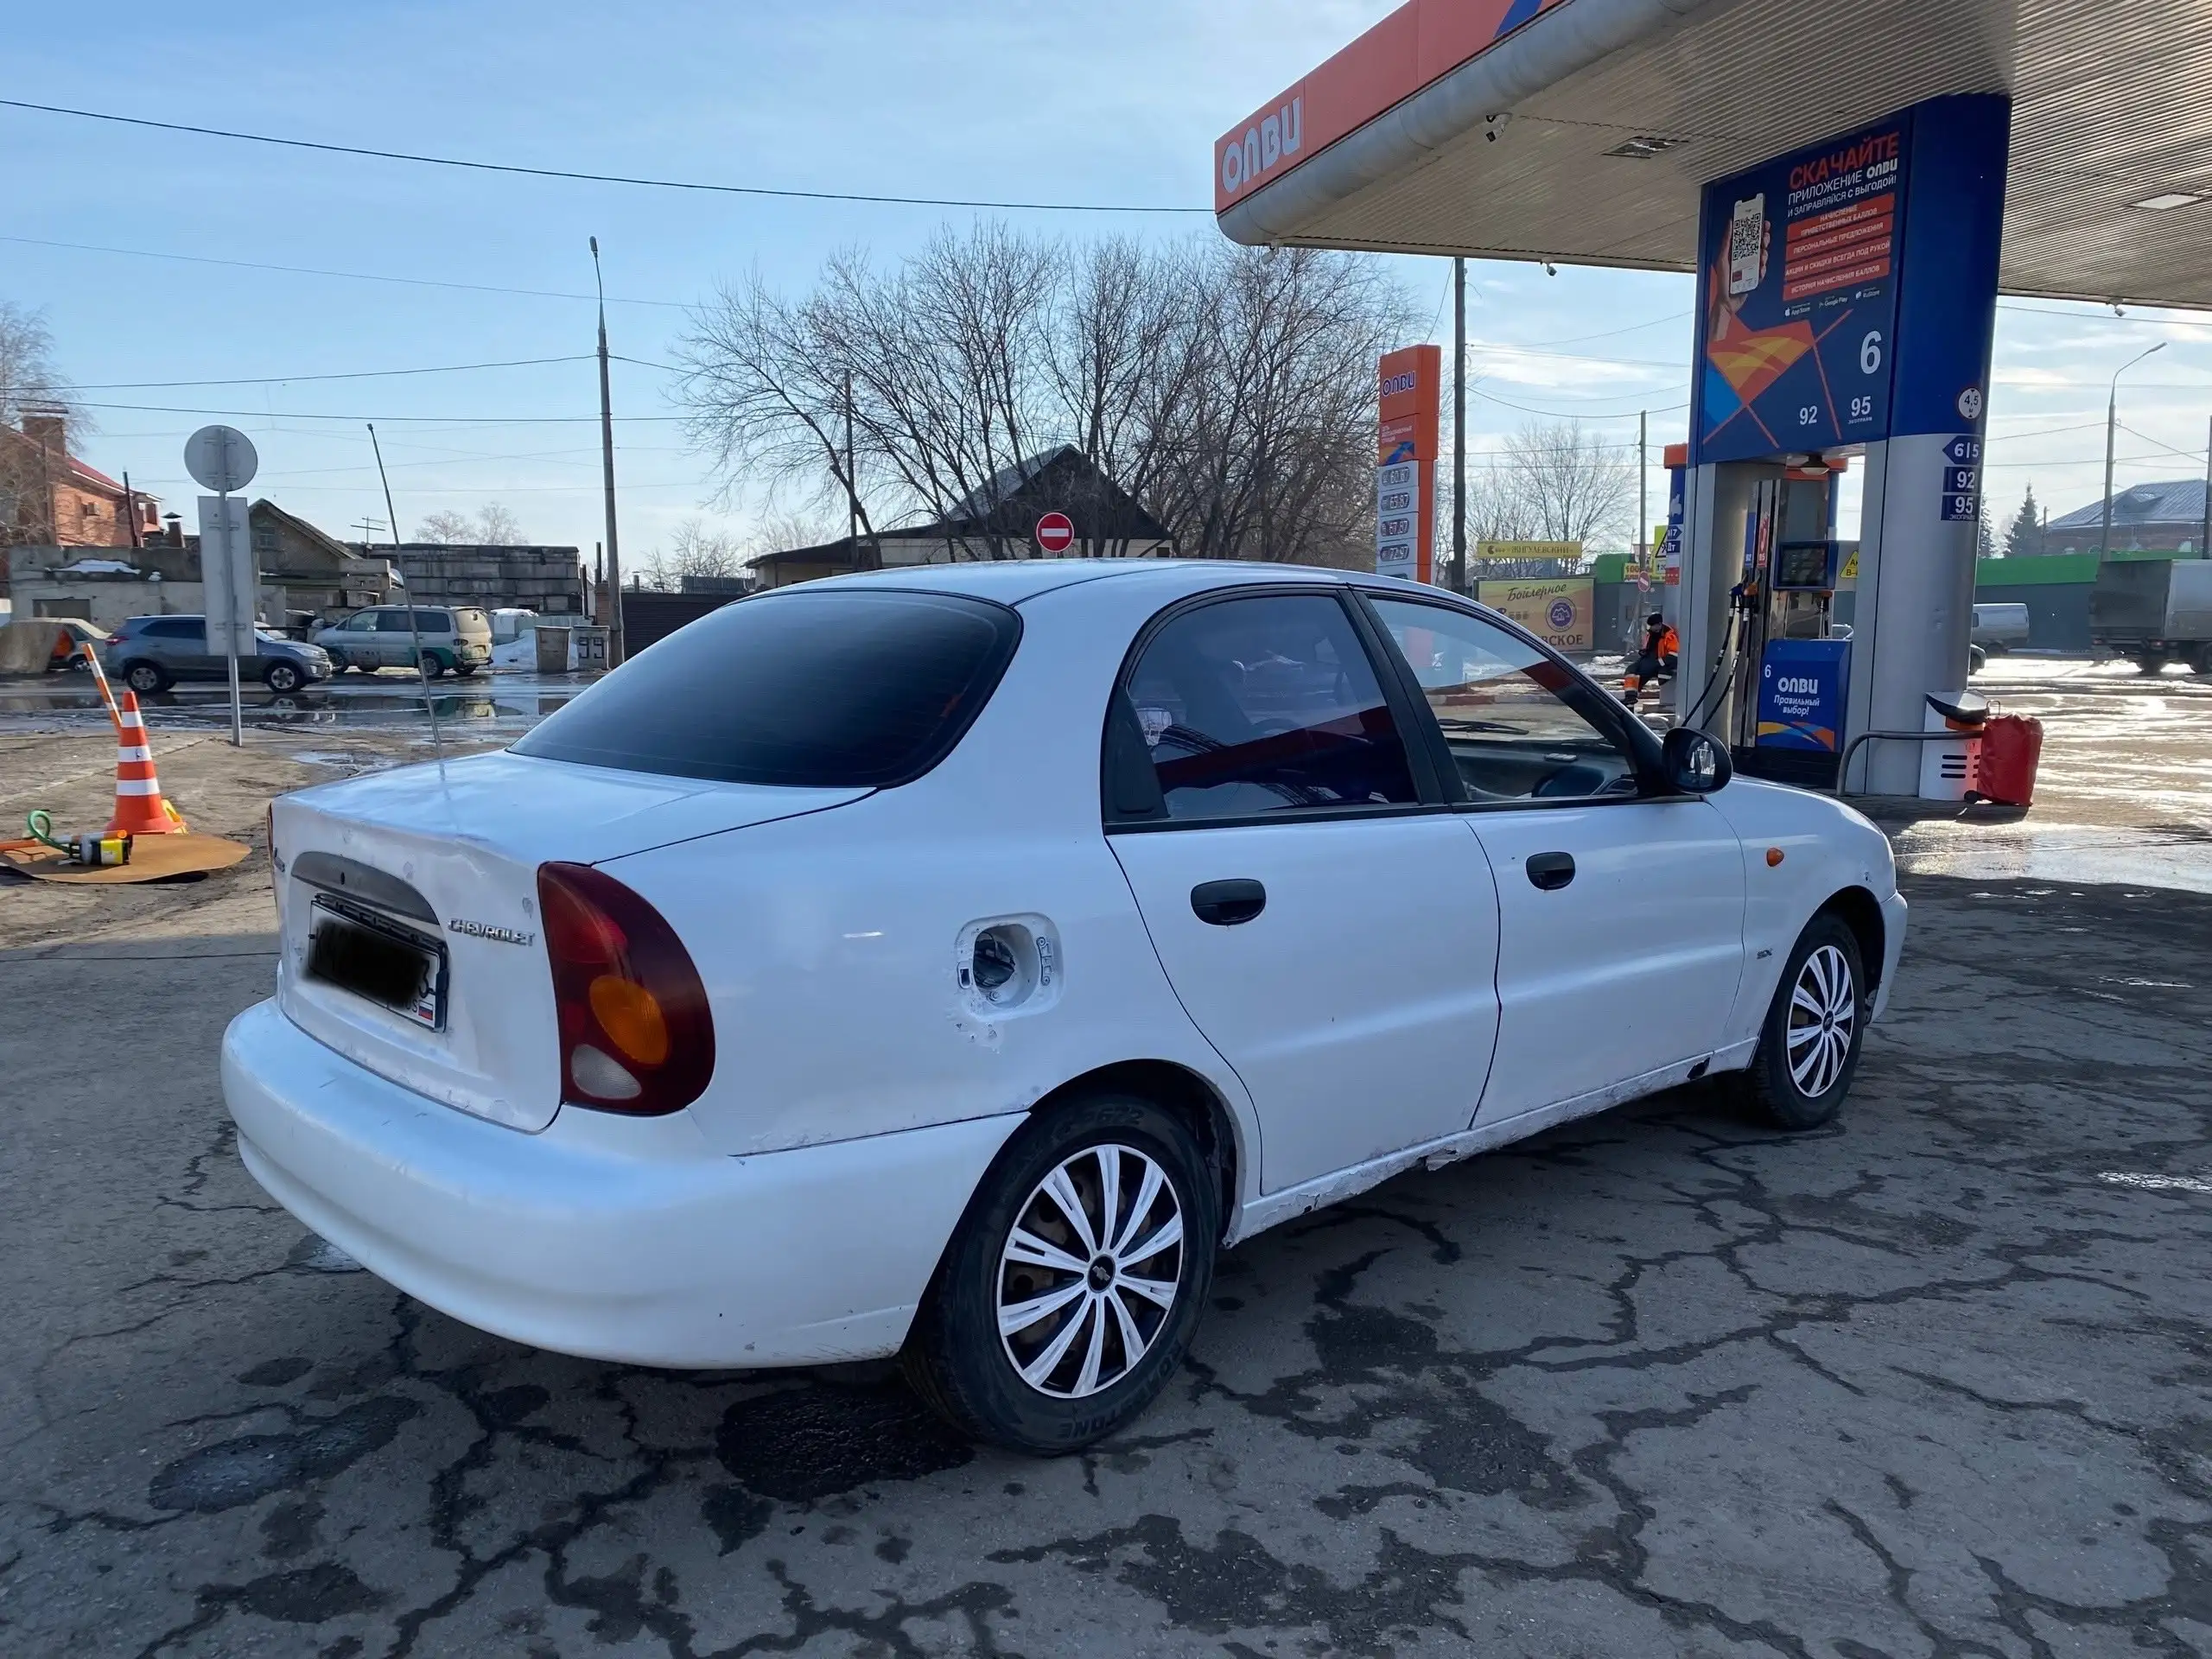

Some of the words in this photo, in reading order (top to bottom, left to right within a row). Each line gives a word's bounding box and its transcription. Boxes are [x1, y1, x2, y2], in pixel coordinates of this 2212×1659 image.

[1789, 131, 1900, 189] СКАЧАЙТЕ
[1787, 209, 1794, 218] И
[1794, 192, 1847, 216] ЗАПРАВЛЯЙСЯ
[1847, 189, 1853, 198] С
[1854, 175, 1897, 196] ВЫГОДОЙ!
[1788, 170, 1862, 206] ПРИЛОЖЕНИЕ
[1793, 235, 1838, 254] ПЕРСОНАЛЬНЫЕ
[1833, 251, 1855, 264] ВСЕГДА
[1855, 247, 1869, 257] ПОД
[1860, 330, 1882, 374] 6
[1851, 396, 1872, 416] 95
[1964, 395, 1979, 407] 4,5
[1799, 405, 1818, 425] 92
[1956, 472, 1975, 489] 92
[1955, 497, 1974, 513] 95
[1507, 583, 1567, 601] Бойлерное
[1764, 664, 1771, 677] 6
[1777, 677, 1818, 694] ОЛВИ
[1774, 695, 1820, 706] Правильный
[1783, 705, 1809, 717] выбор!
[448, 918, 536, 946] CHEVROLET
